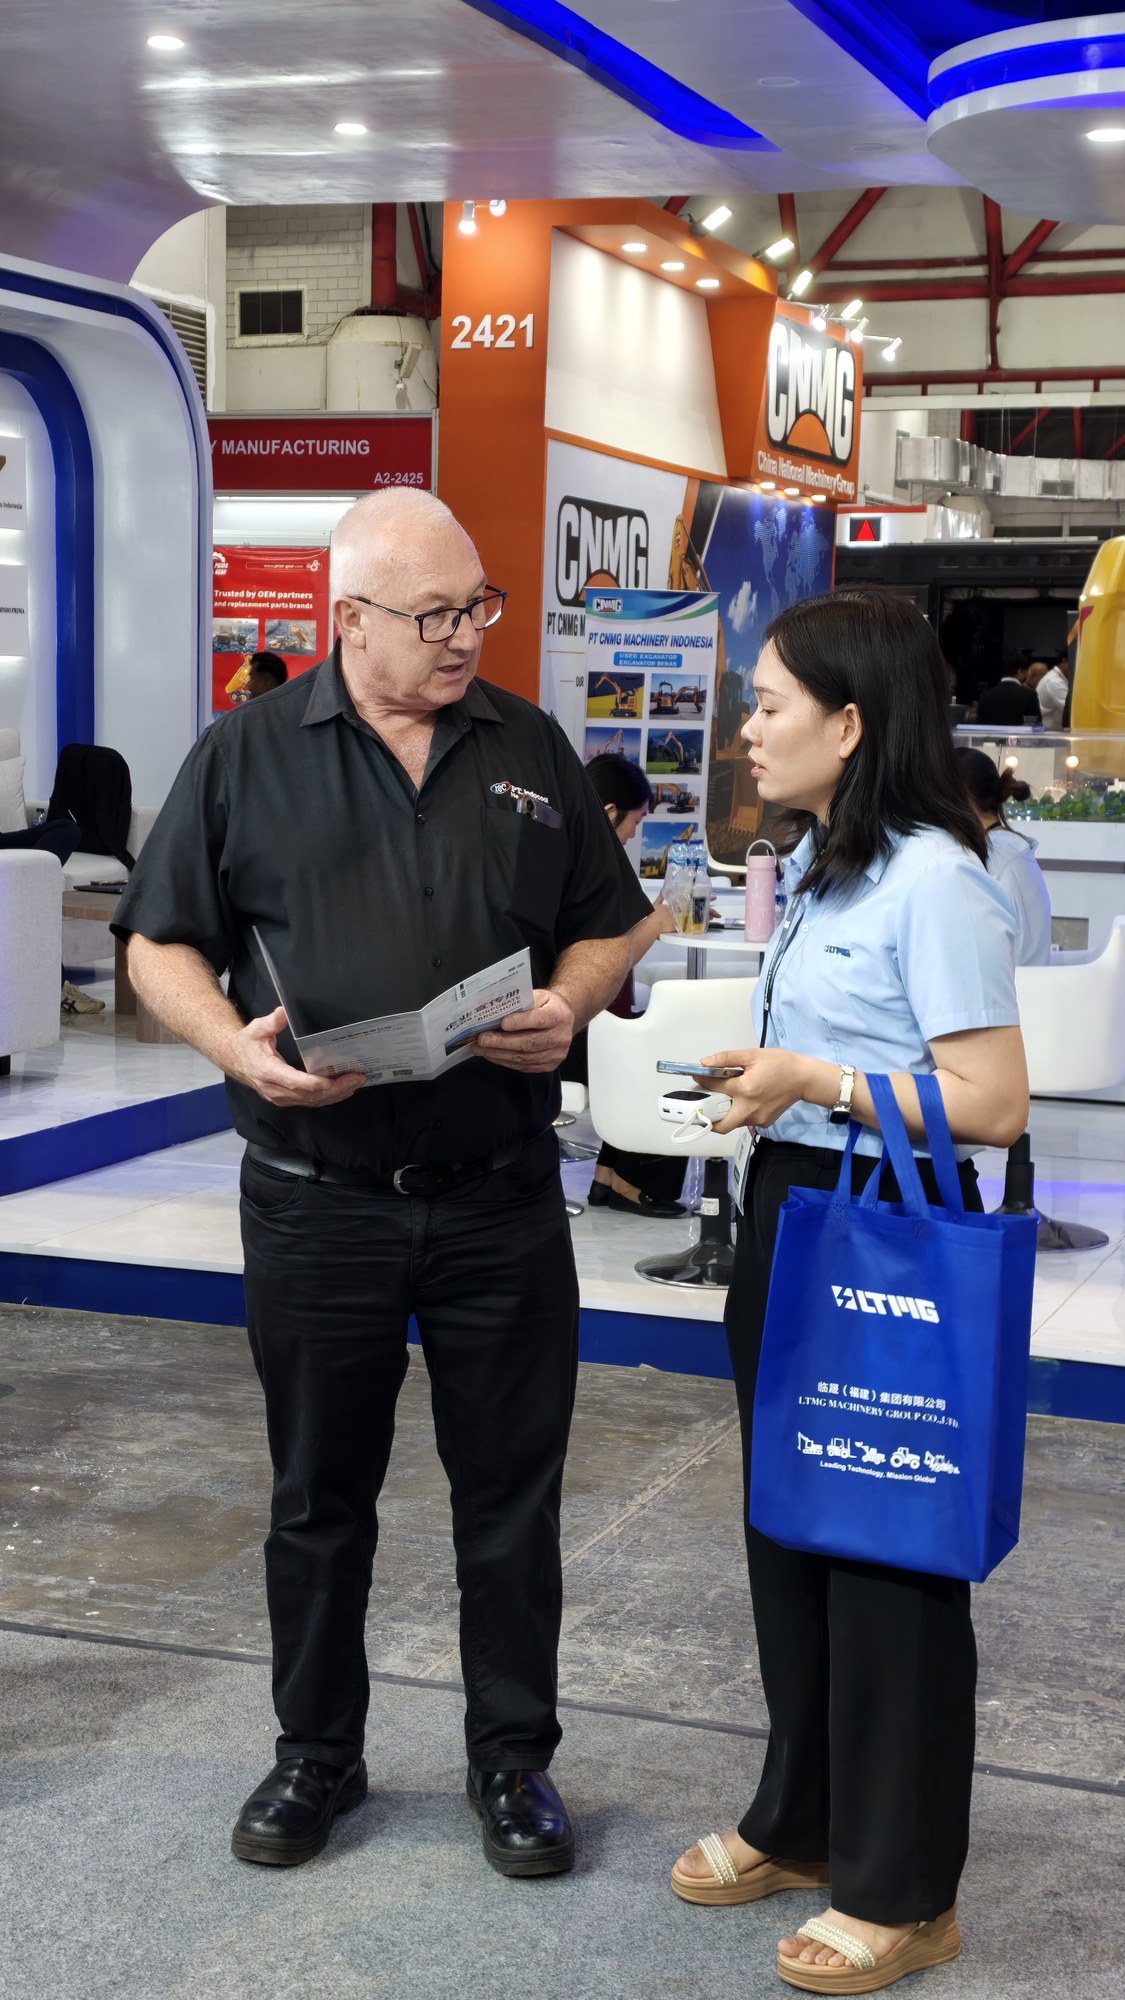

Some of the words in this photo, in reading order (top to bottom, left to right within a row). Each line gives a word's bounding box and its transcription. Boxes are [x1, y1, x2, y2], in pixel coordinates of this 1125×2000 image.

[451, 313, 534, 349] 2421
[767, 321, 854, 460] CNMG
[221, 440, 370, 455] MANUFACTURING
[374, 472, 424, 484] A2-2425
[758, 450, 778, 476] China
[778, 456, 805, 483] National
[805, 464, 837, 496] Machinery
[836, 473, 855, 500] Group
[557, 502, 649, 600] CNMG
[214, 590, 244, 598] Trusted
[246, 590, 256, 599] by
[257, 590, 276, 598] OEM
[277, 592, 313, 600] partners
[227, 601, 269, 609] replacement
[547, 612, 556, 635] PT
[558, 612, 578, 636] CNMG
[588, 632, 599, 645] PT
[600, 632, 622, 645] CNMG
[623, 633, 669, 647] MACHINERY
[670, 635, 713, 648] INDONESIA
[856, 1289, 940, 1324] LTMG
[798, 1396, 827, 1407] LTMG
[828, 1399, 885, 1417] MACHINERY
[886, 1409, 921, 1421] GROUP
[820, 1460, 847, 1472] Leading
[847, 1464, 886, 1479] Technology,
[886, 1471, 913, 1481] Mission
[913, 1474, 937, 1484] Global
